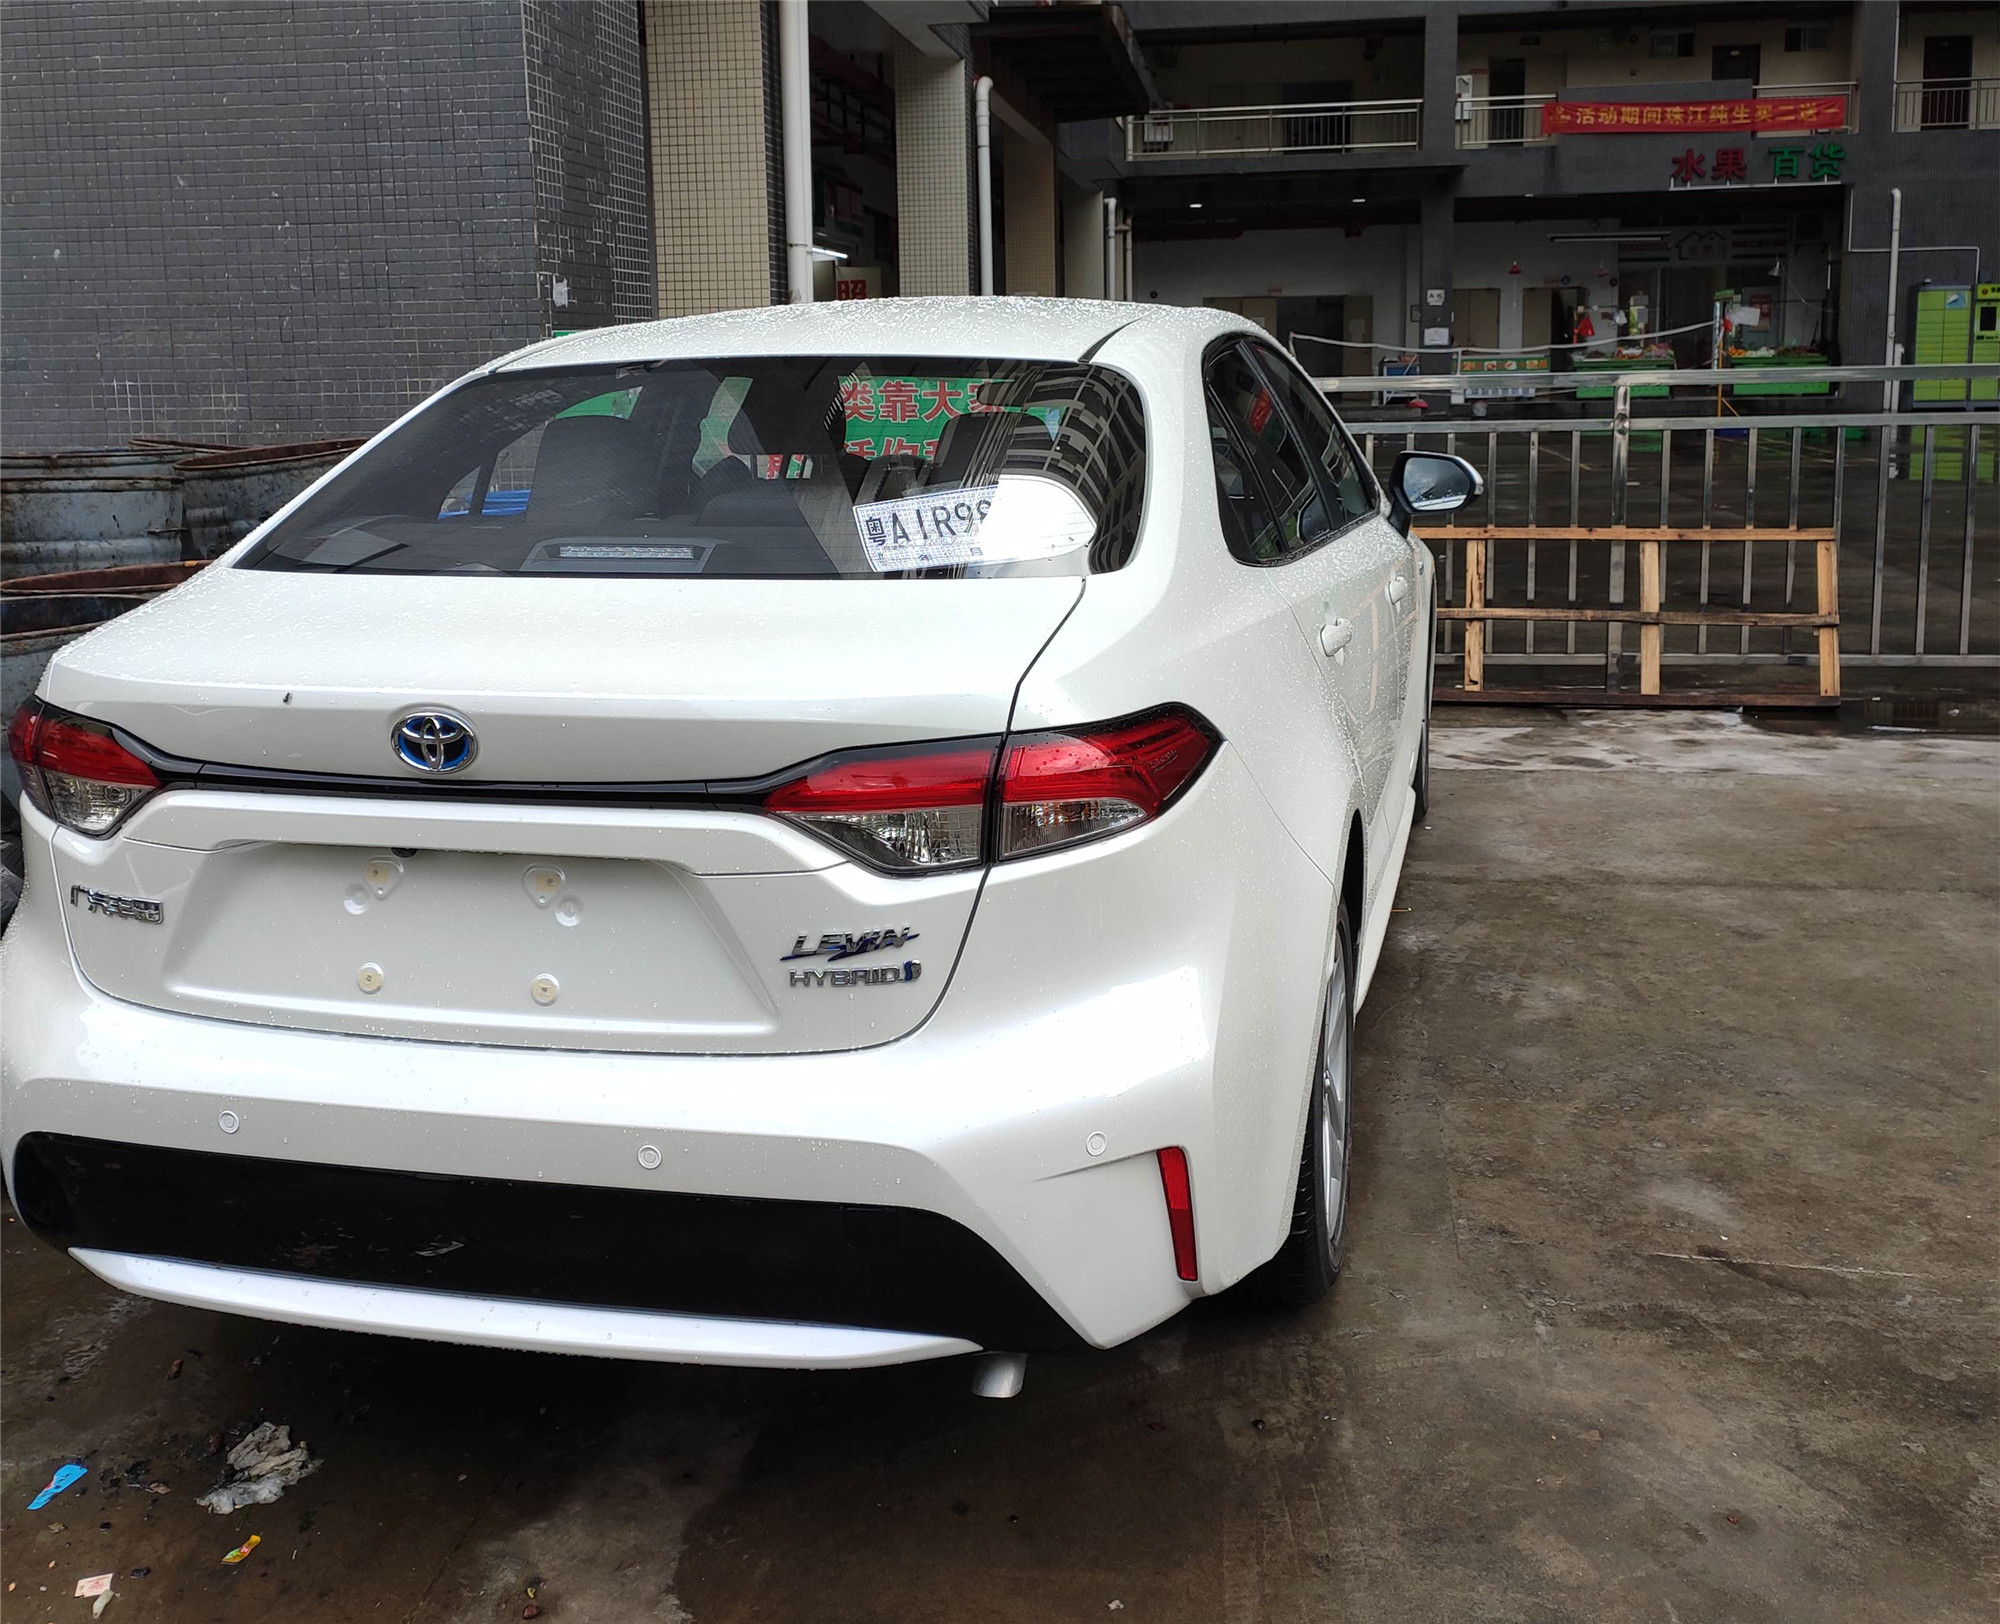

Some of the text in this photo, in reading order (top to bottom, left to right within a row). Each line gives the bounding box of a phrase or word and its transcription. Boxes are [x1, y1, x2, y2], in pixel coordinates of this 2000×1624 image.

[1576, 103, 1840, 125] 活动期间珠江纯生买二送一
[1672, 143, 1847, 182] 水果 百货
[789, 925, 912, 957] LEVIN
[789, 964, 900, 987] HYBRID
